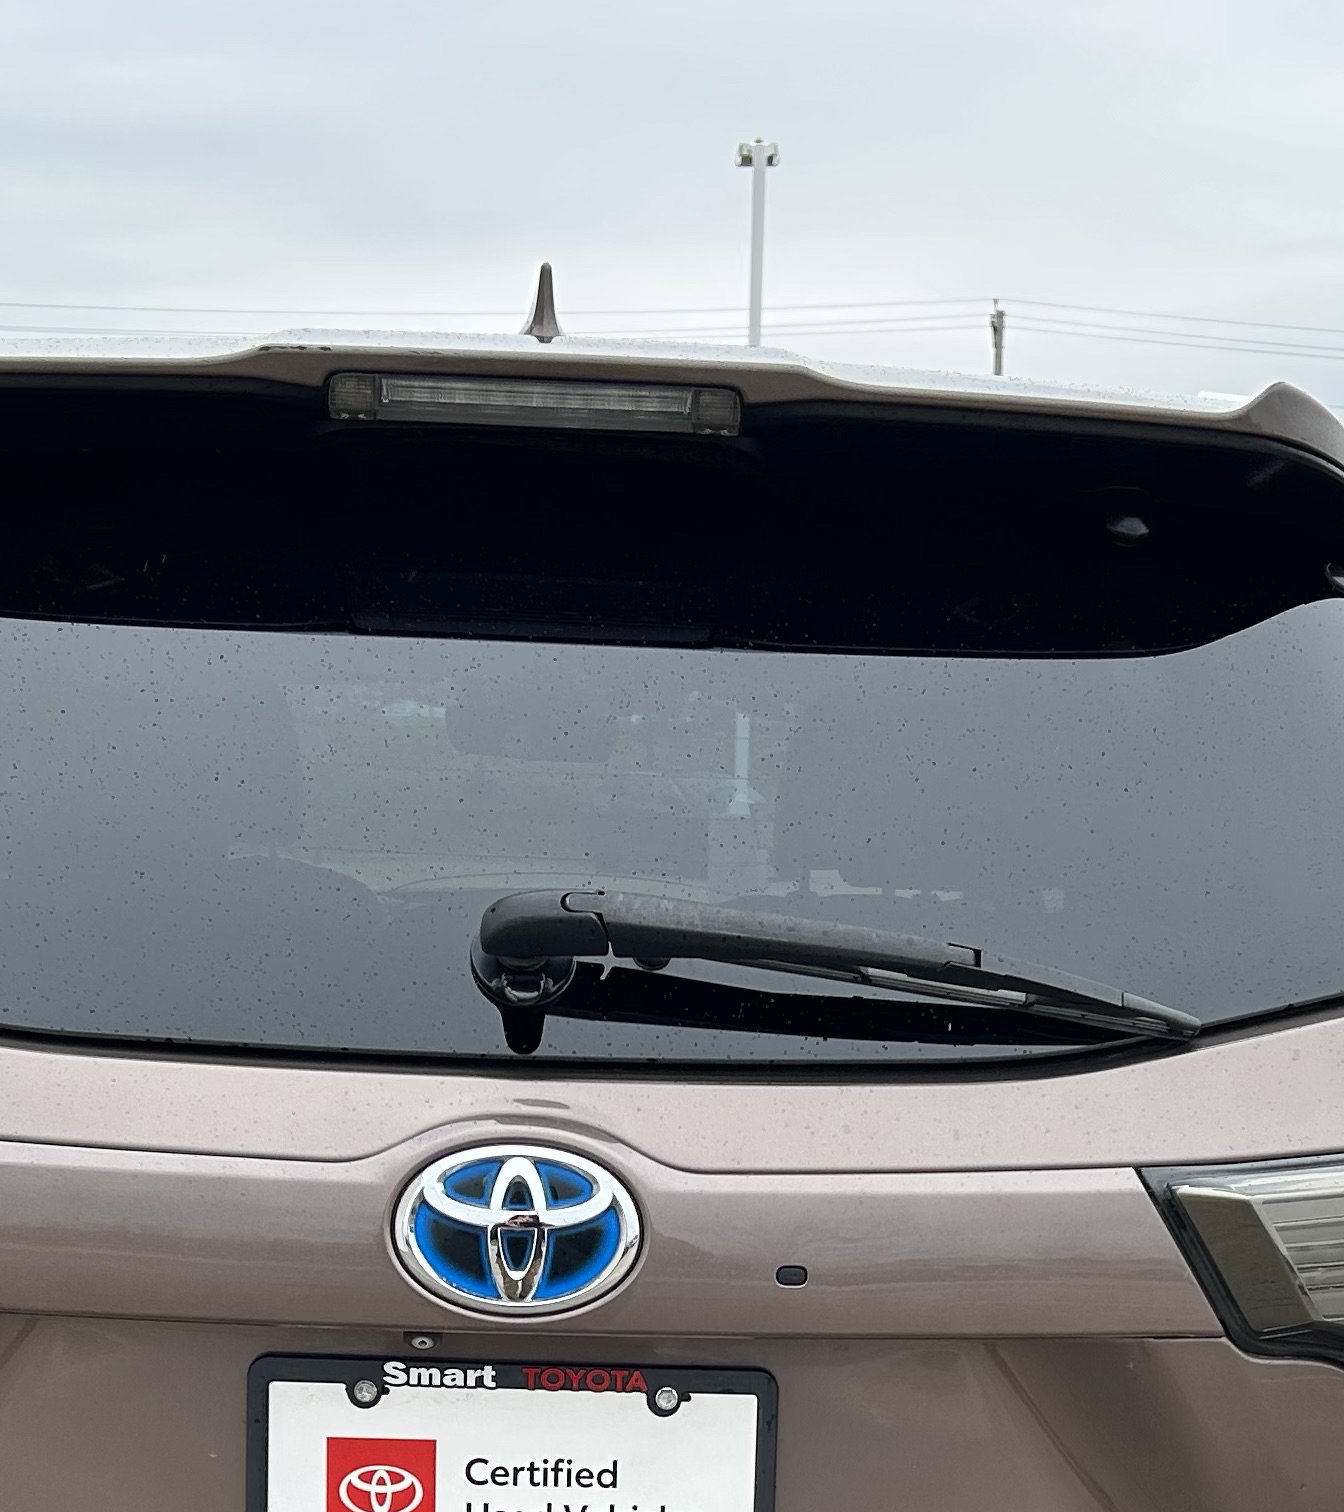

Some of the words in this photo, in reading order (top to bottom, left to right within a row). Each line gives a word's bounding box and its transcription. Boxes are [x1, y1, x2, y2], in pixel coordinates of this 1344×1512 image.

[383, 1361, 497, 1388] Smart
[521, 1367, 648, 1393] TOYOTA
[465, 1458, 619, 1489] Certified
